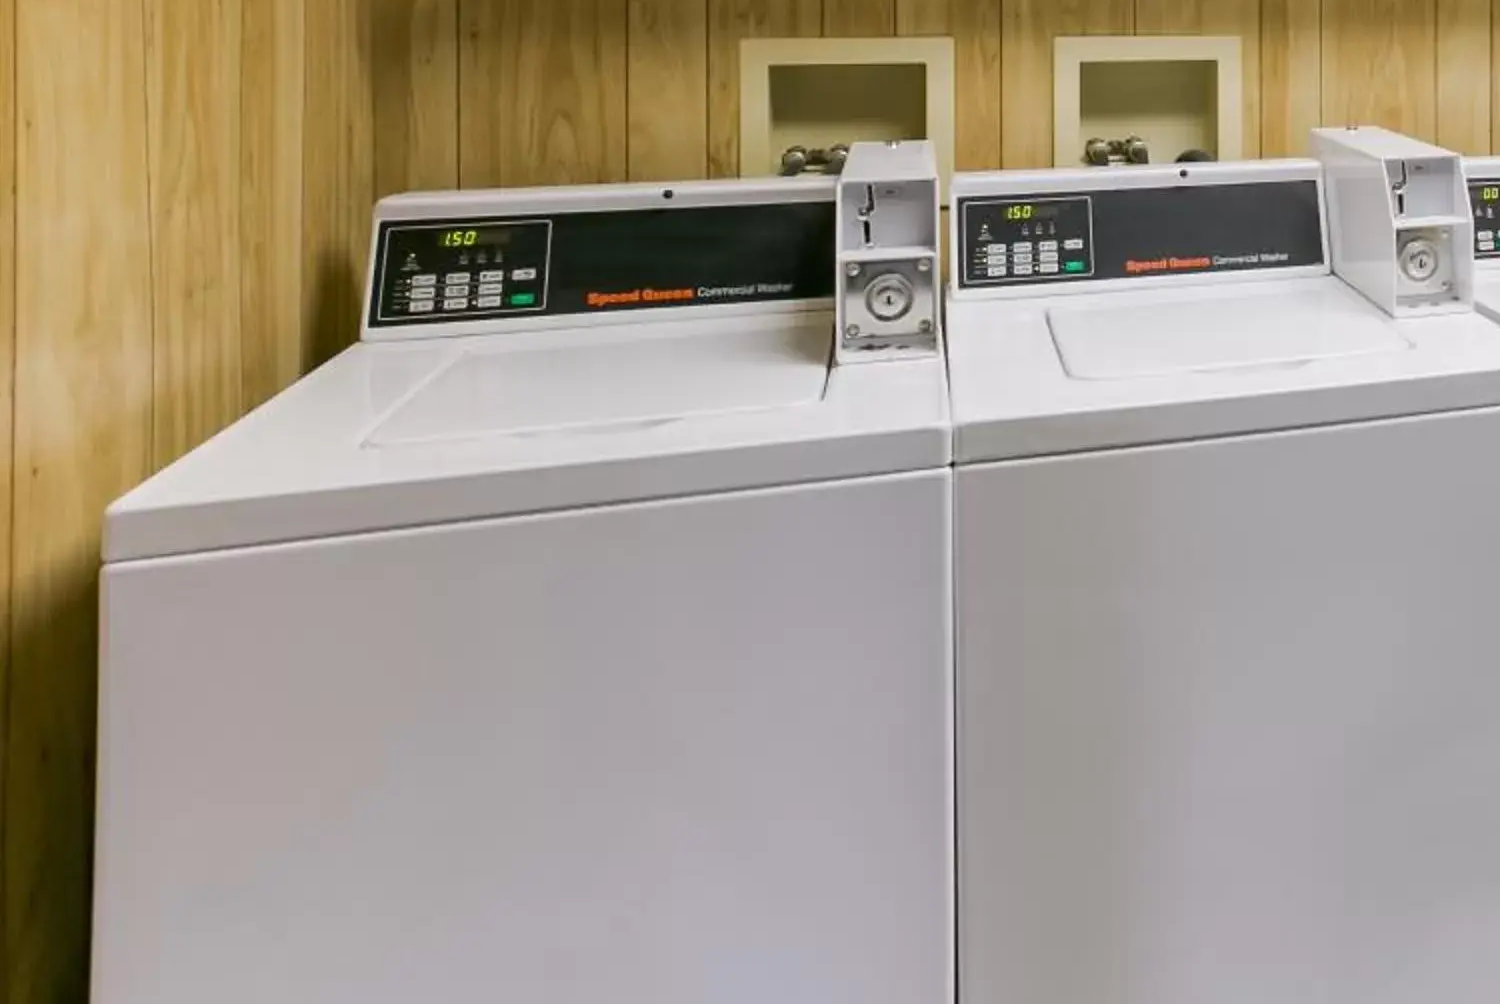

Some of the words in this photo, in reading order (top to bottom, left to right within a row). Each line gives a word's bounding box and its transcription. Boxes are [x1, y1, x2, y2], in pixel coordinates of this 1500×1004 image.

[1126, 258, 1168, 273] Speed
[1169, 256, 1211, 269] Queen
[586, 289, 640, 308] Speed
[642, 287, 694, 302] Queen
[697, 284, 755, 298] Commercial
